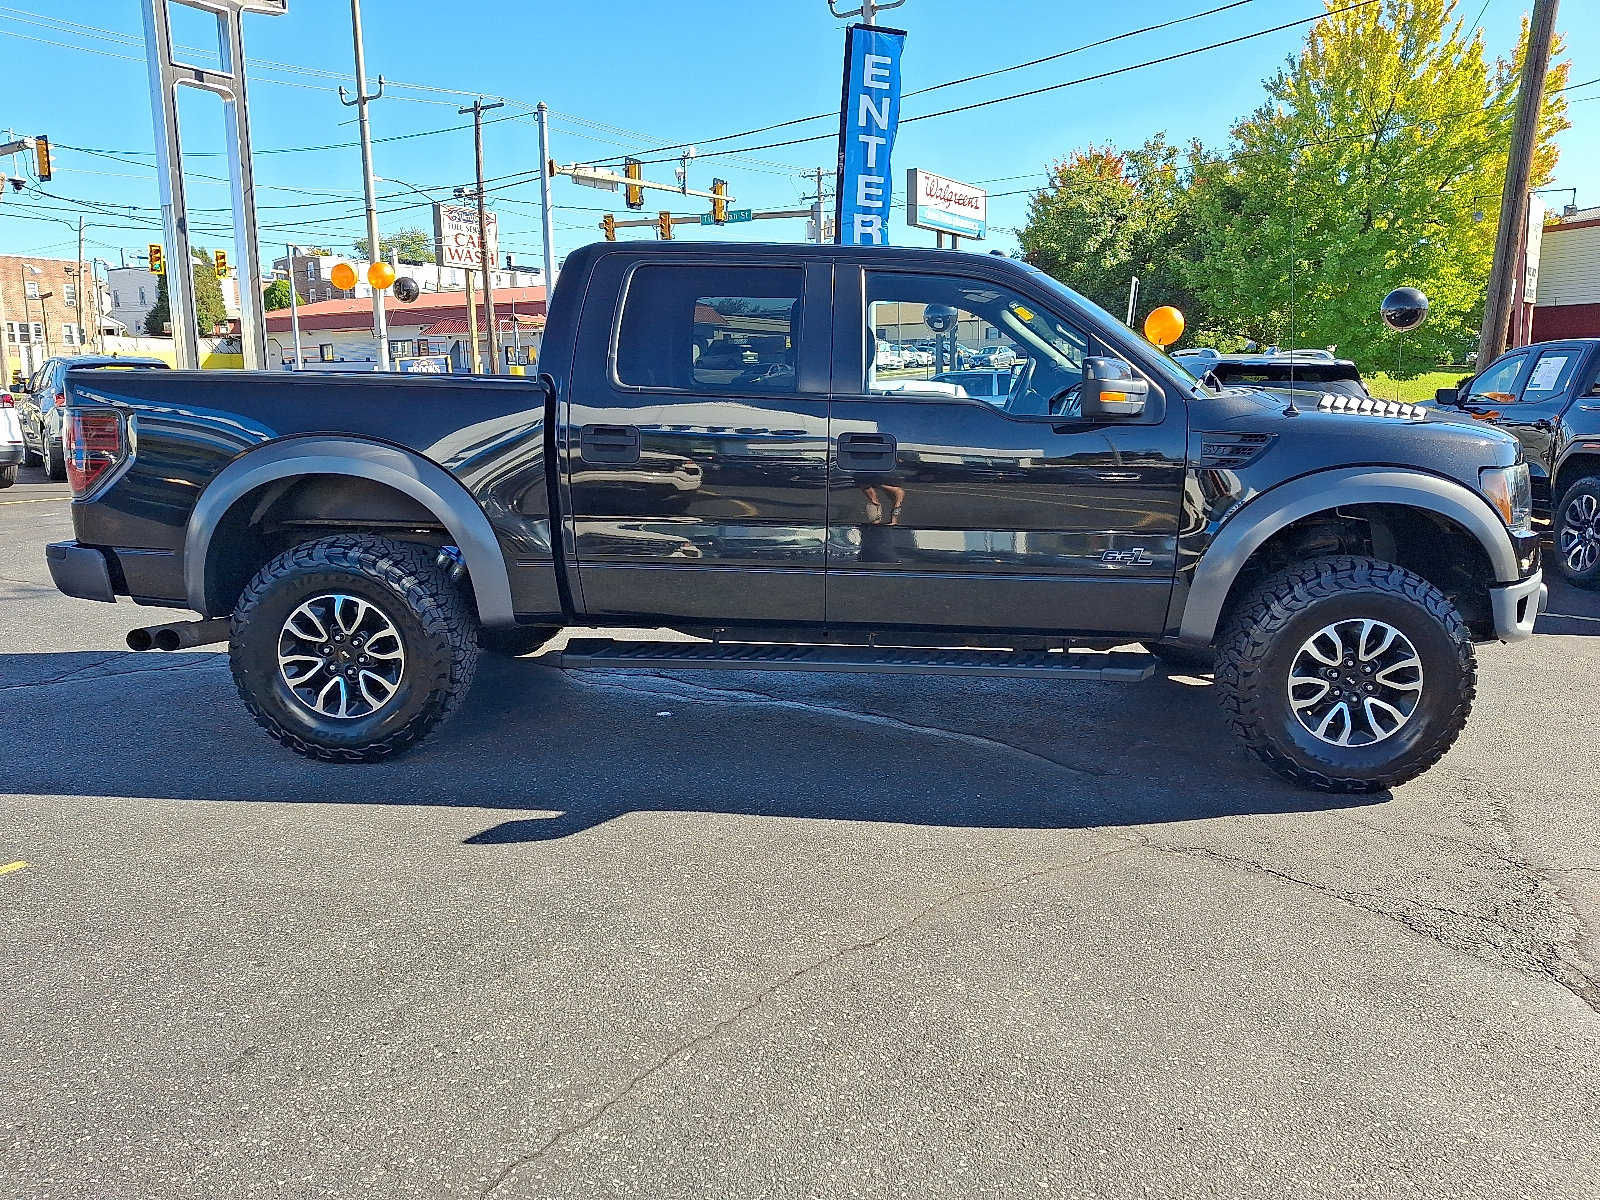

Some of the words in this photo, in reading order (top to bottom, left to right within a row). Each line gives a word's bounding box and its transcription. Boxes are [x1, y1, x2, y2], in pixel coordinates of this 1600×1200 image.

[853, 53, 892, 245] ENTER
[924, 176, 980, 209] Walgreens
[703, 213, 738, 223] Tilan
[740, 211, 749, 220] St
[447, 247, 495, 265] WASH
[1203, 445, 1227, 455] SVT
[1101, 547, 1154, 566] 6.2L
